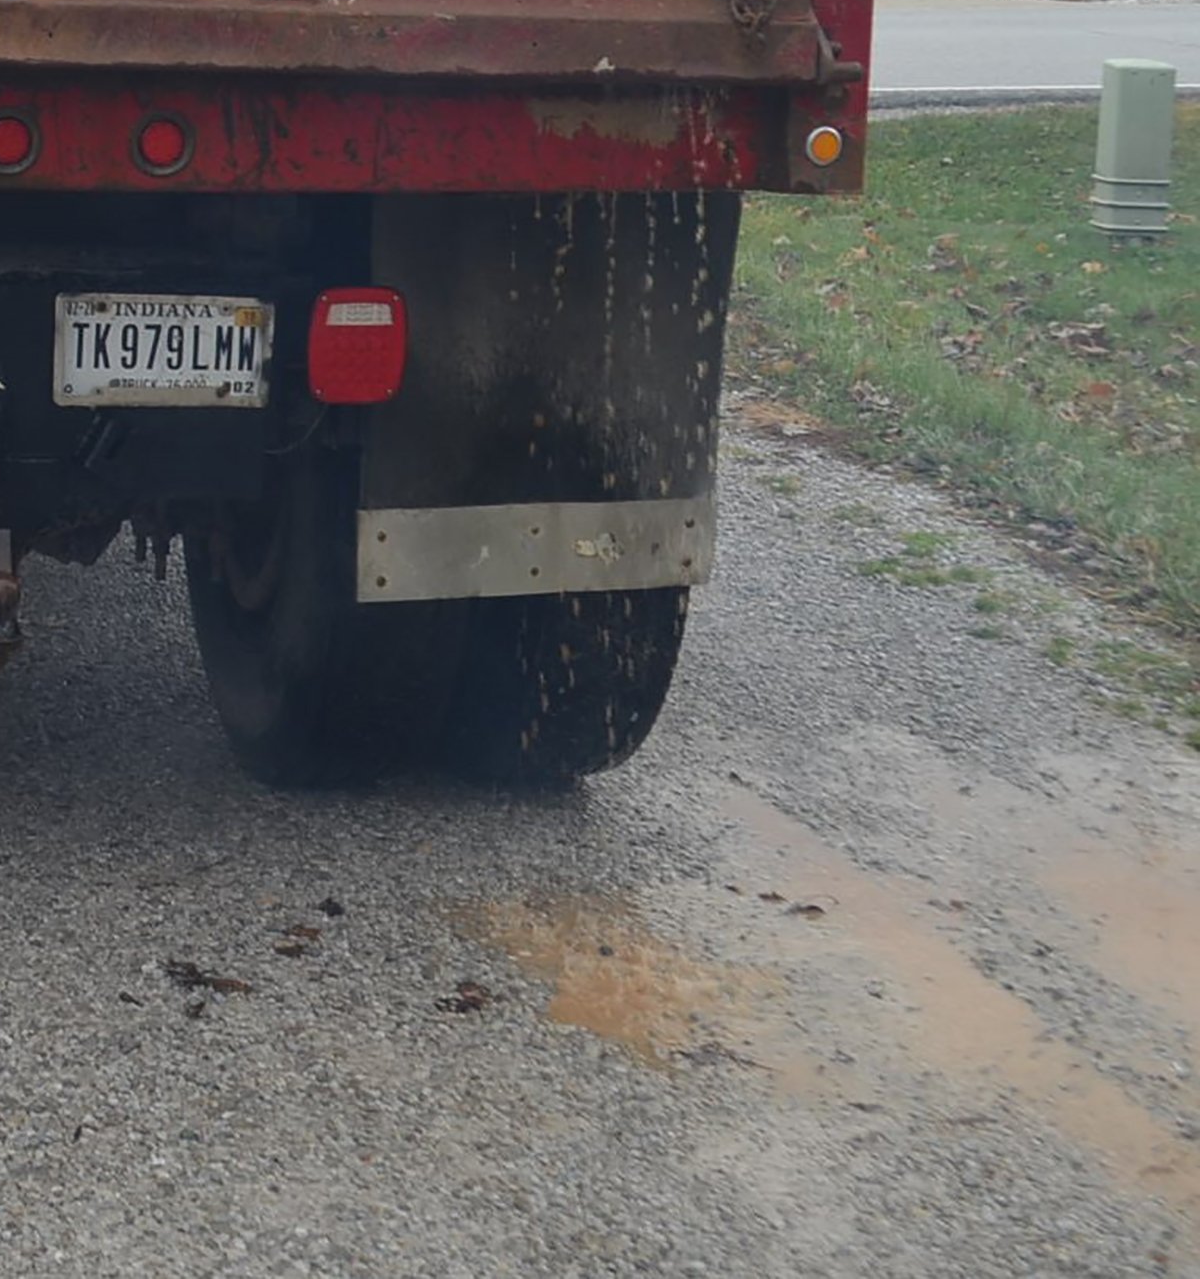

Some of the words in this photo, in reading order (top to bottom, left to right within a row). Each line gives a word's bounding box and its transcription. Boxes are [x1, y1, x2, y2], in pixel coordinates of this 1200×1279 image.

[112, 301, 213, 319] INDIANA
[72, 322, 257, 372] TK979LMW
[232, 380, 255, 394] 02
